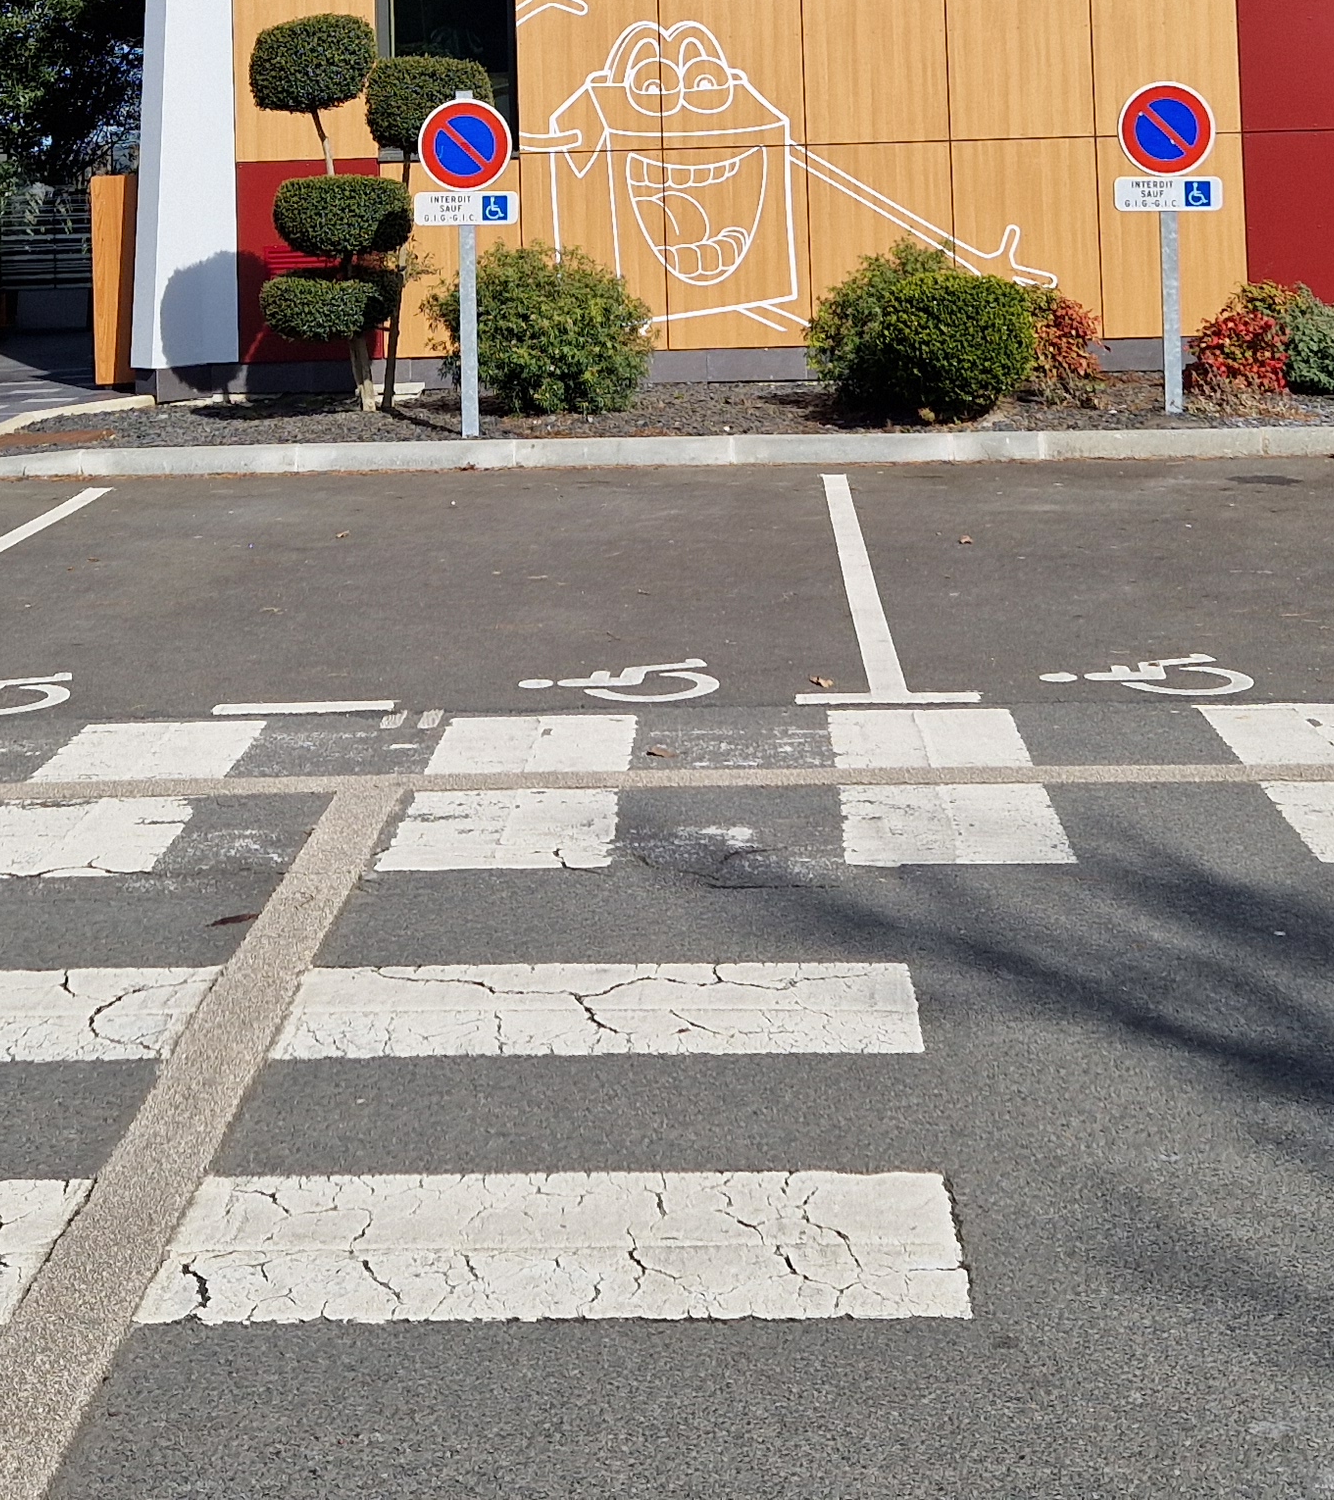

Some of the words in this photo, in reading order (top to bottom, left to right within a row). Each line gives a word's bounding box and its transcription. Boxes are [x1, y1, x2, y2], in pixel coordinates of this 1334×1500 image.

[1131, 180, 1173, 189] INTERDIT
[1141, 190, 1164, 198] SAUF
[430, 195, 471, 203] INTERDIT
